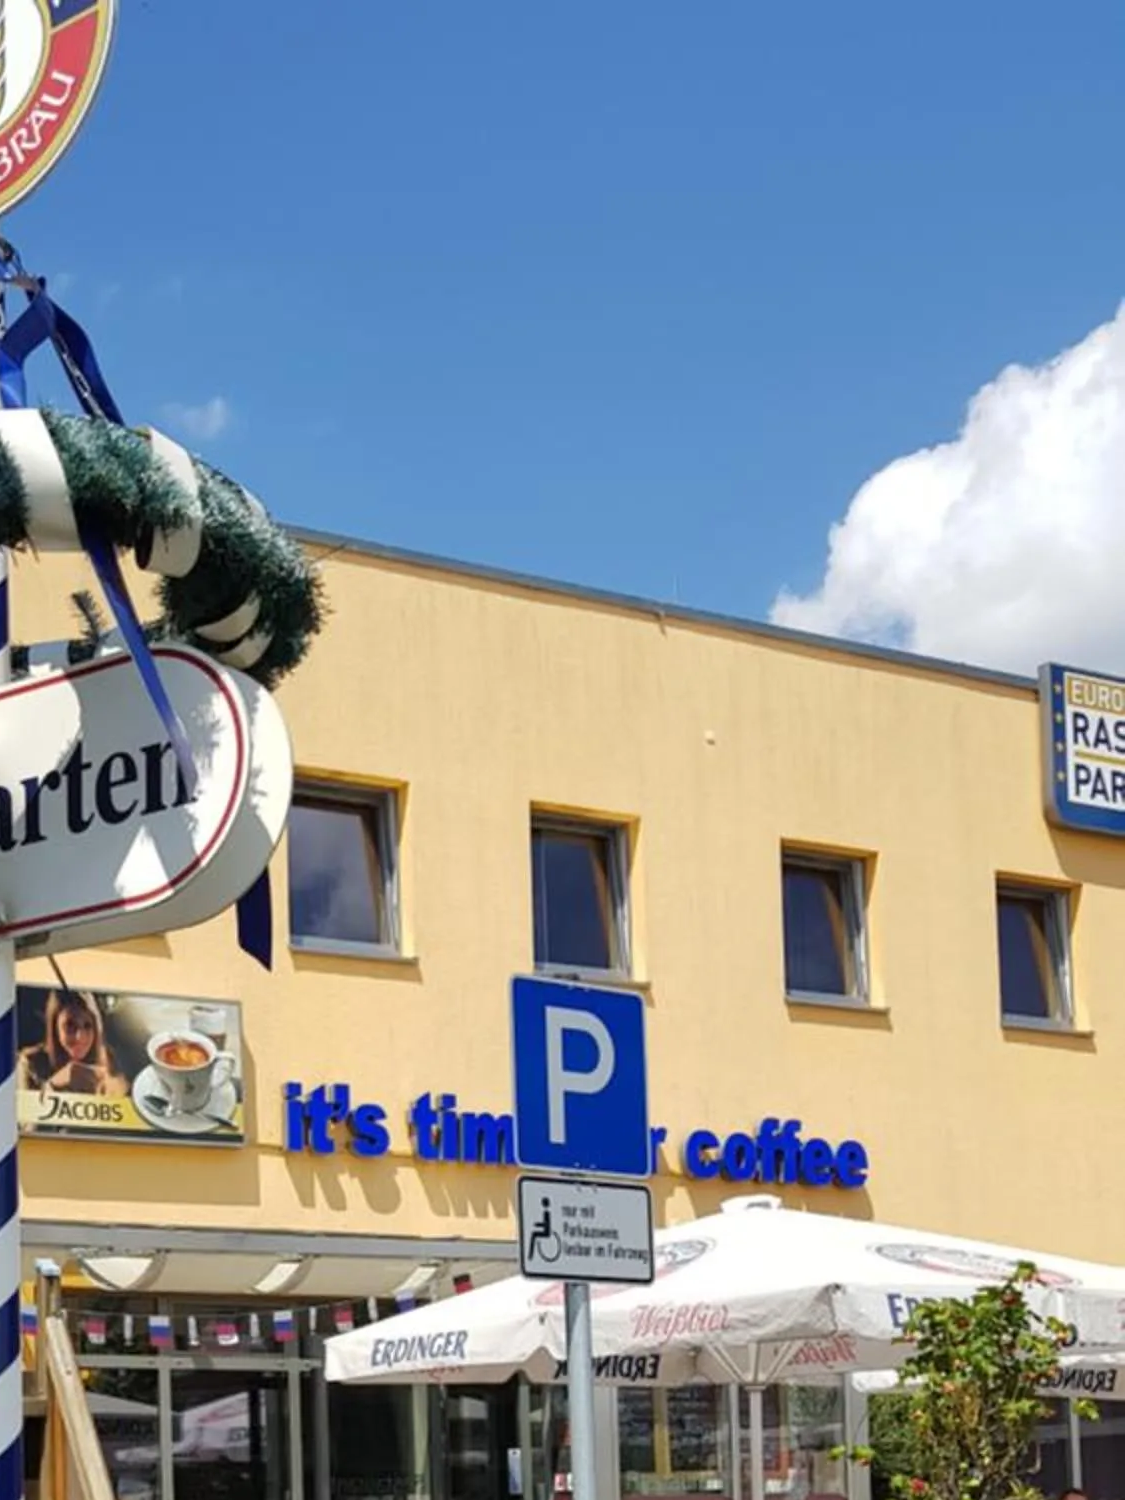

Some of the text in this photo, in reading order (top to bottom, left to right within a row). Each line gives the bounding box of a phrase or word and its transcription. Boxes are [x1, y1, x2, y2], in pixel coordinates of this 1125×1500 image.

[39, 1096, 123, 1123] JACOBS
[544, 1005, 616, 1145] P
[282, 1081, 390, 1157] it's
[410, 1091, 516, 1165] tim
[685, 1117, 869, 1189] coffee
[371, 1330, 468, 1369] ERDINGER
